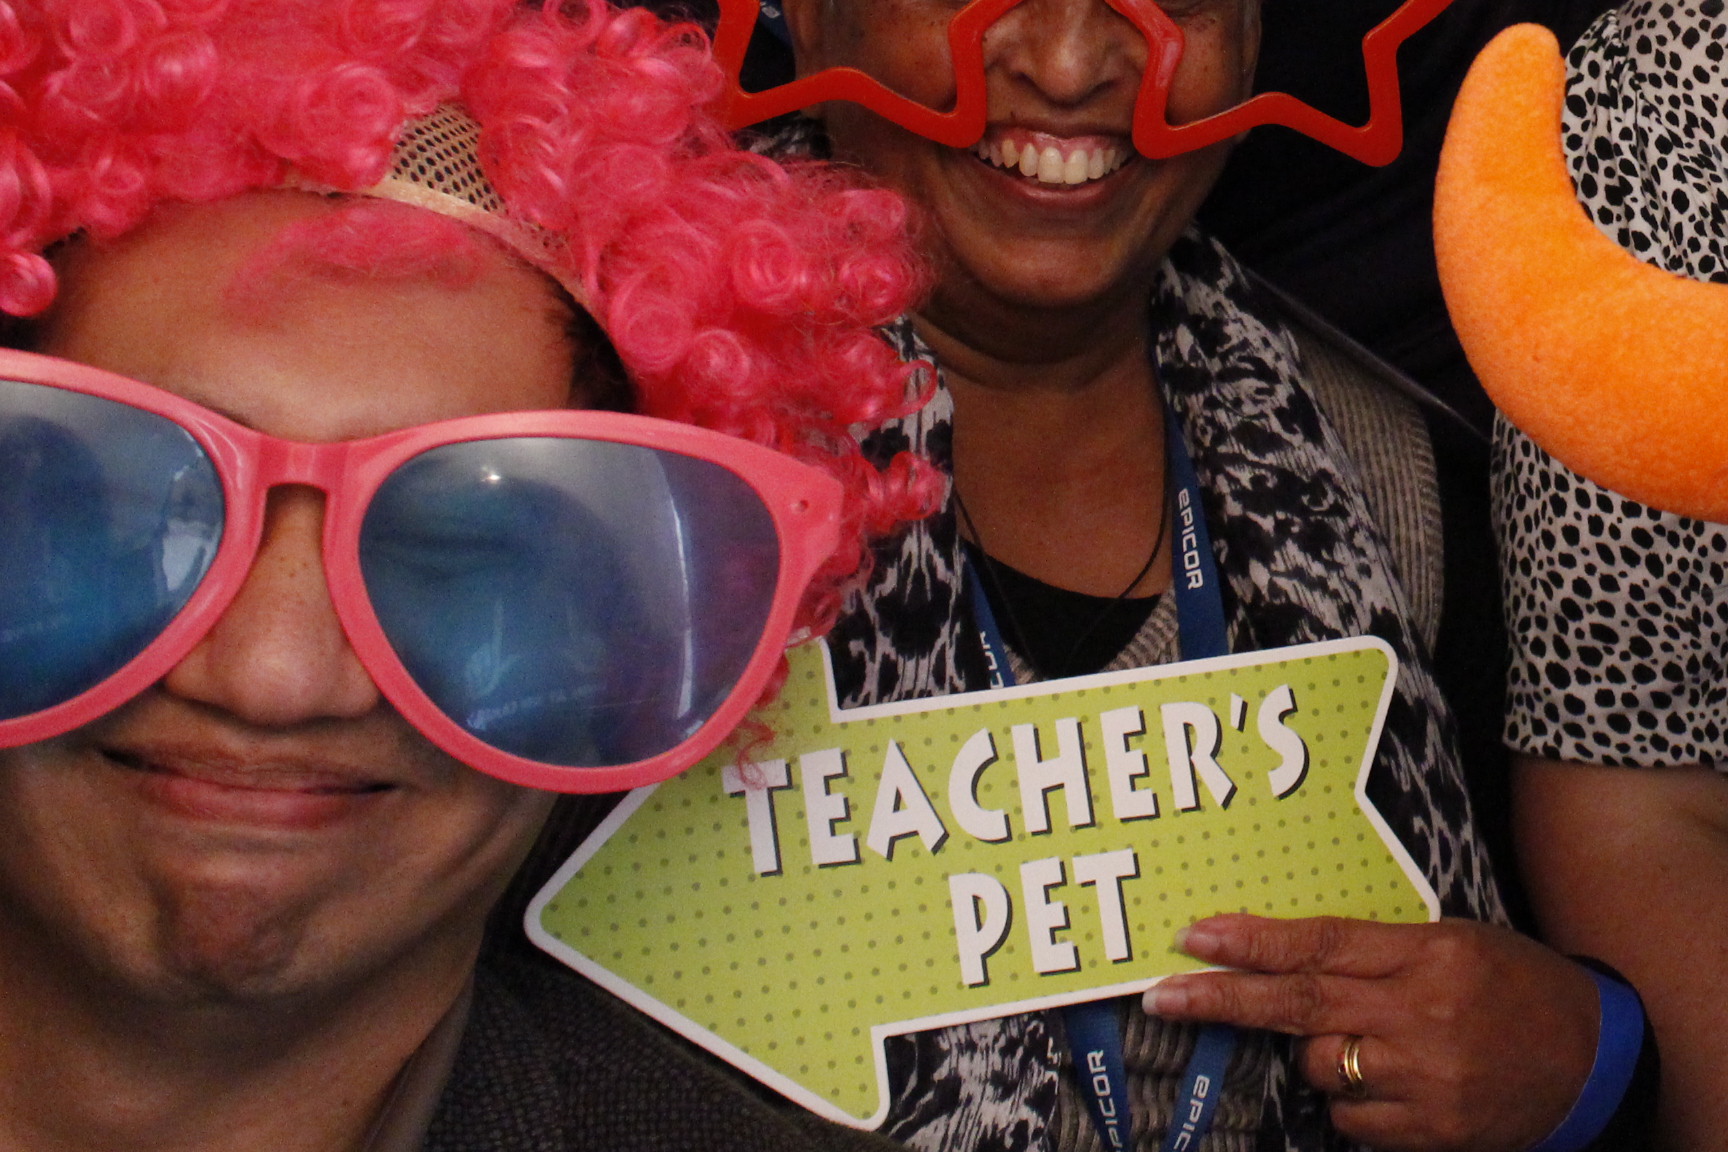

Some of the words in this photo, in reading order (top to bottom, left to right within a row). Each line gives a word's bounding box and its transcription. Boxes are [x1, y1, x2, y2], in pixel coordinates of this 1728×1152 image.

[1178, 488, 1204, 590] EPICOR
[722, 684, 1309, 876] TEACHER'S
[949, 848, 1139, 986] PET
[1087, 1050, 1123, 1152] PICOR
